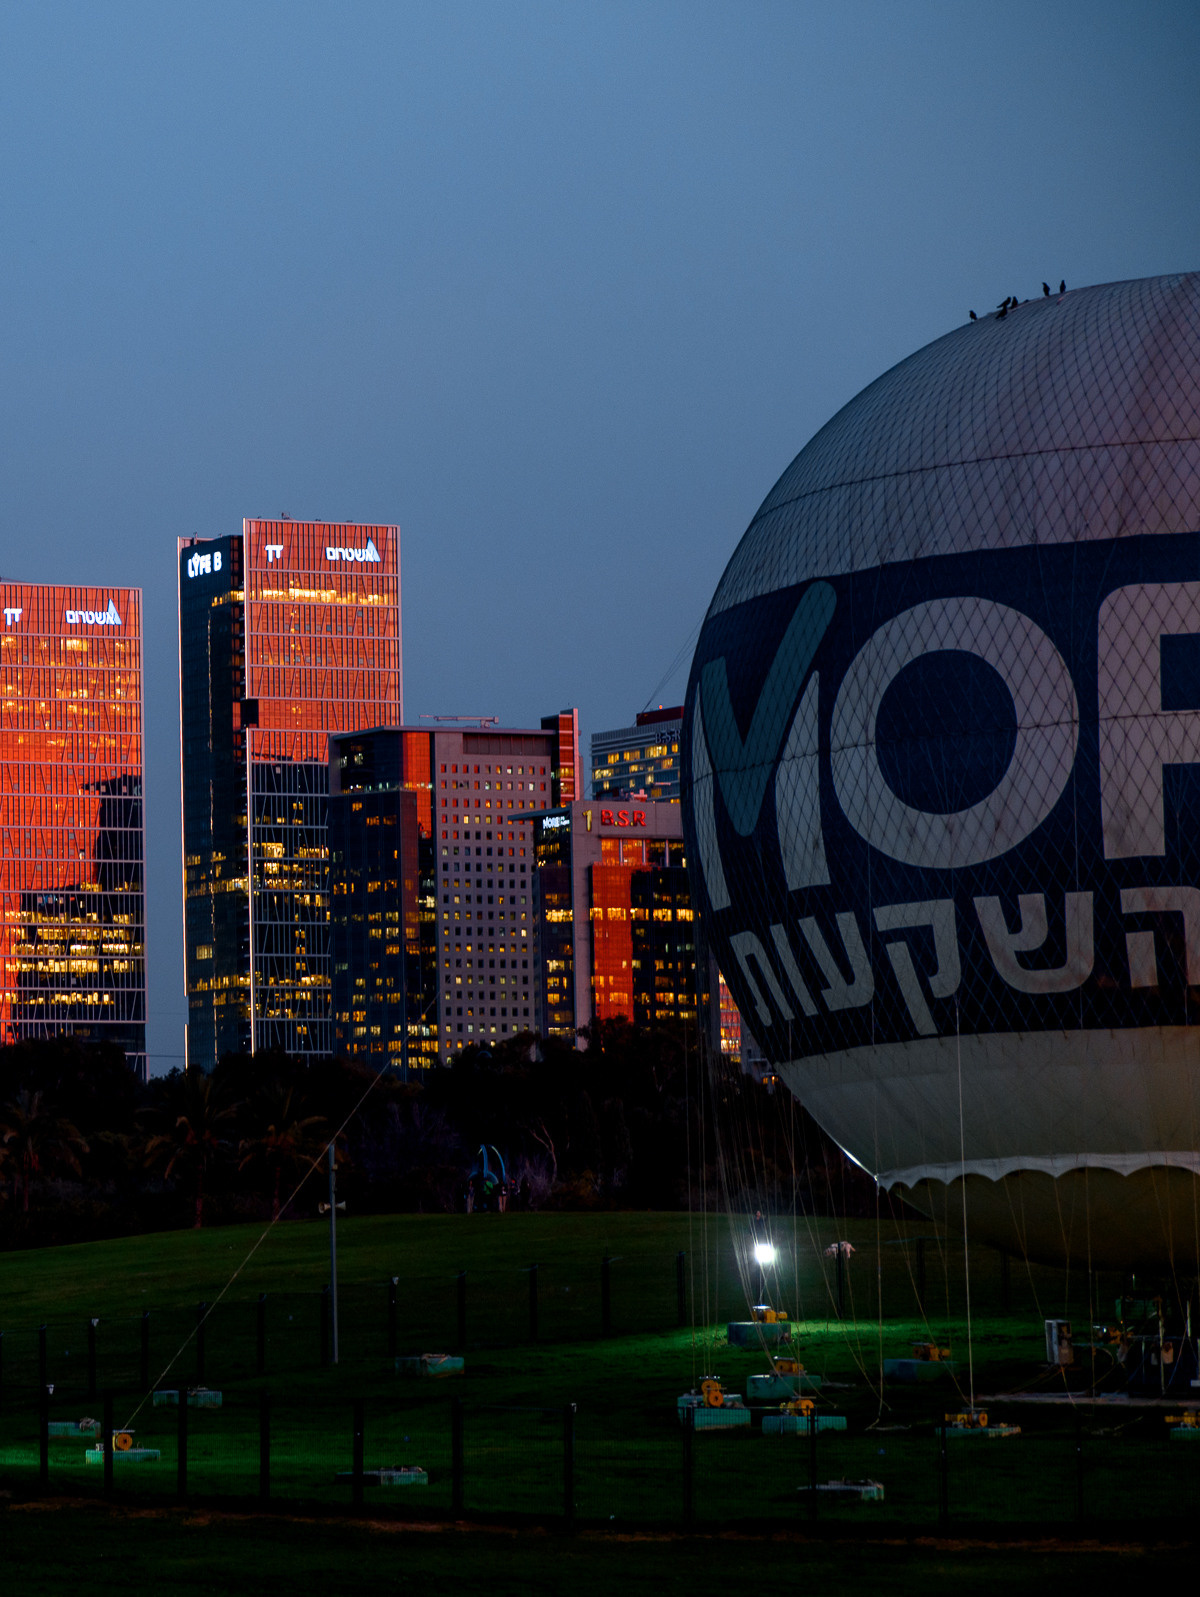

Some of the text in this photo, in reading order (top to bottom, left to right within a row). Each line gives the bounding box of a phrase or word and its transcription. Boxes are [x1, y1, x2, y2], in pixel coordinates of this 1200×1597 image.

[325, 547, 375, 562] אשטרום
[188, 551, 222, 578] LYFE B
[65, 610, 116, 625] אשטרום
[601, 809, 647, 827] B.S.R
[729, 886, 1200, 1036] השקעות
